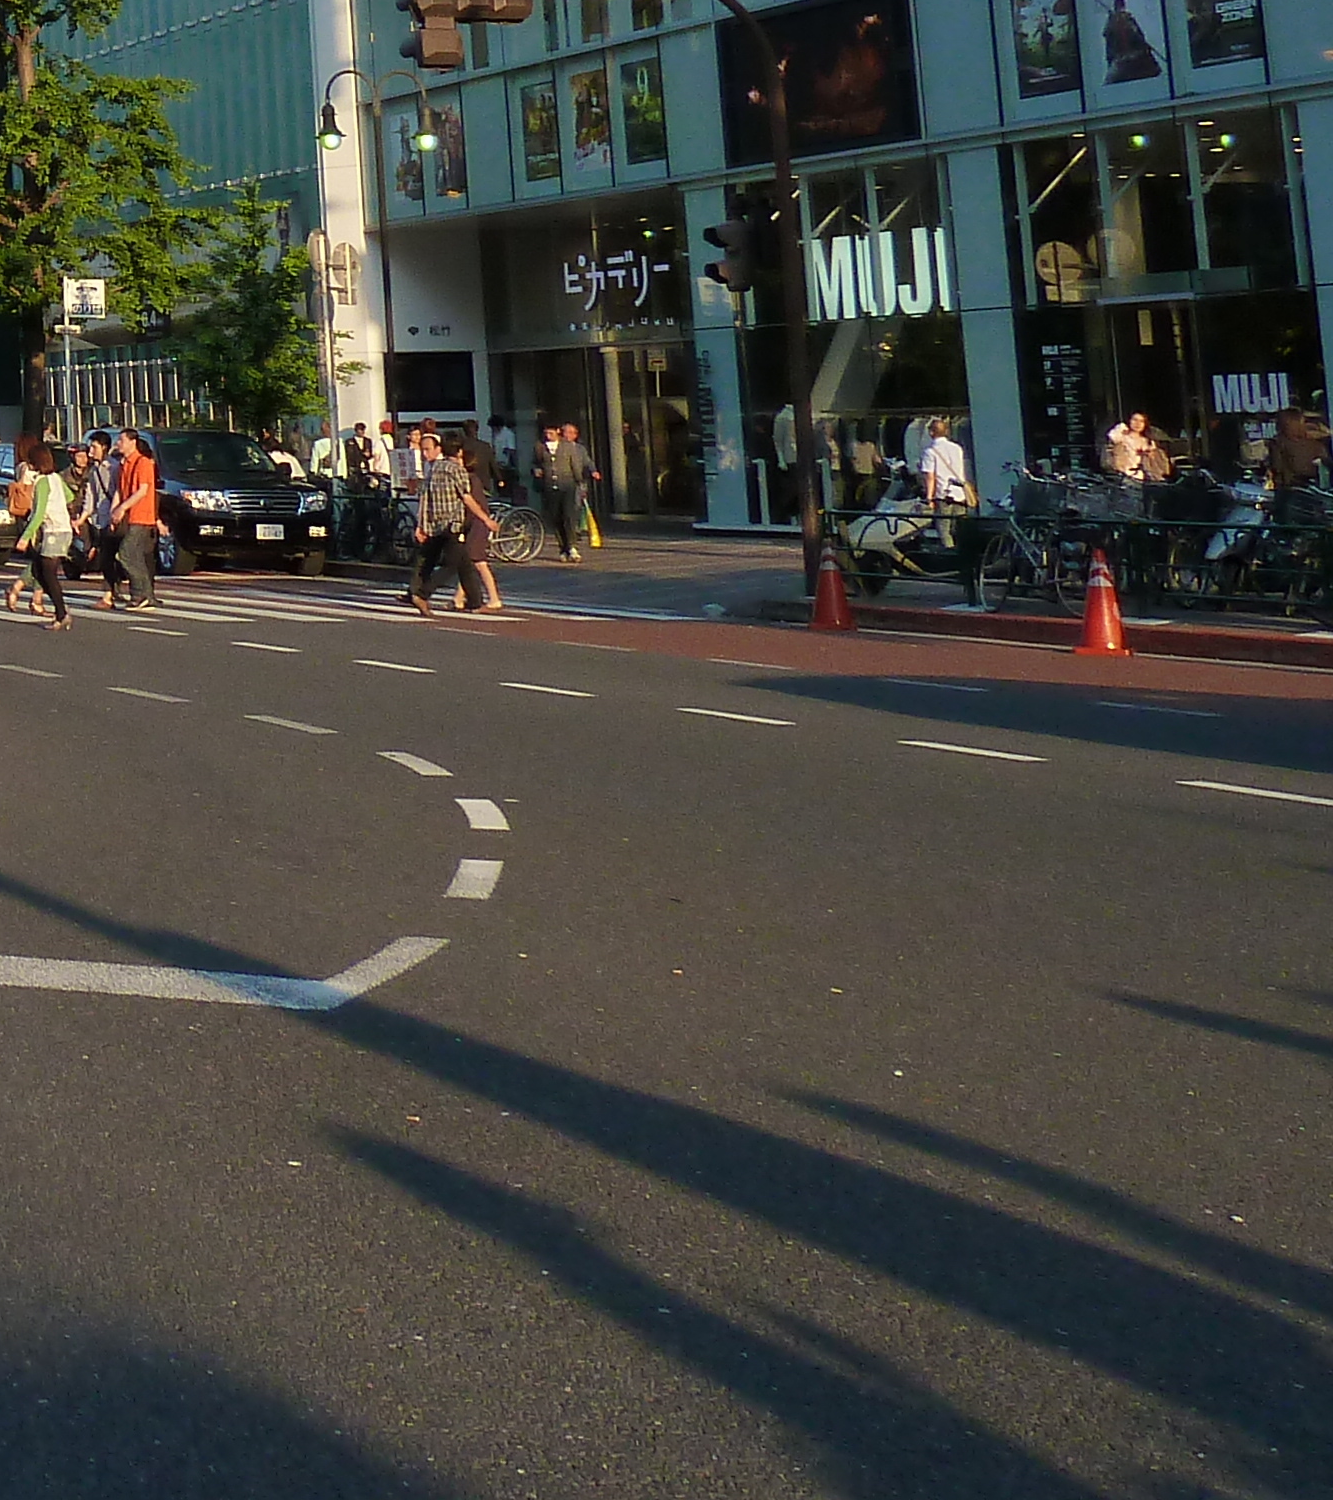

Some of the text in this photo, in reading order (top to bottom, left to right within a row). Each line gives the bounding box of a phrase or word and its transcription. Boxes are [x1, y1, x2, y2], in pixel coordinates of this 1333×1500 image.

[564, 252, 670, 311] ピカデリー
[807, 226, 953, 325] MUJI
[1212, 372, 1290, 414] MUJI
